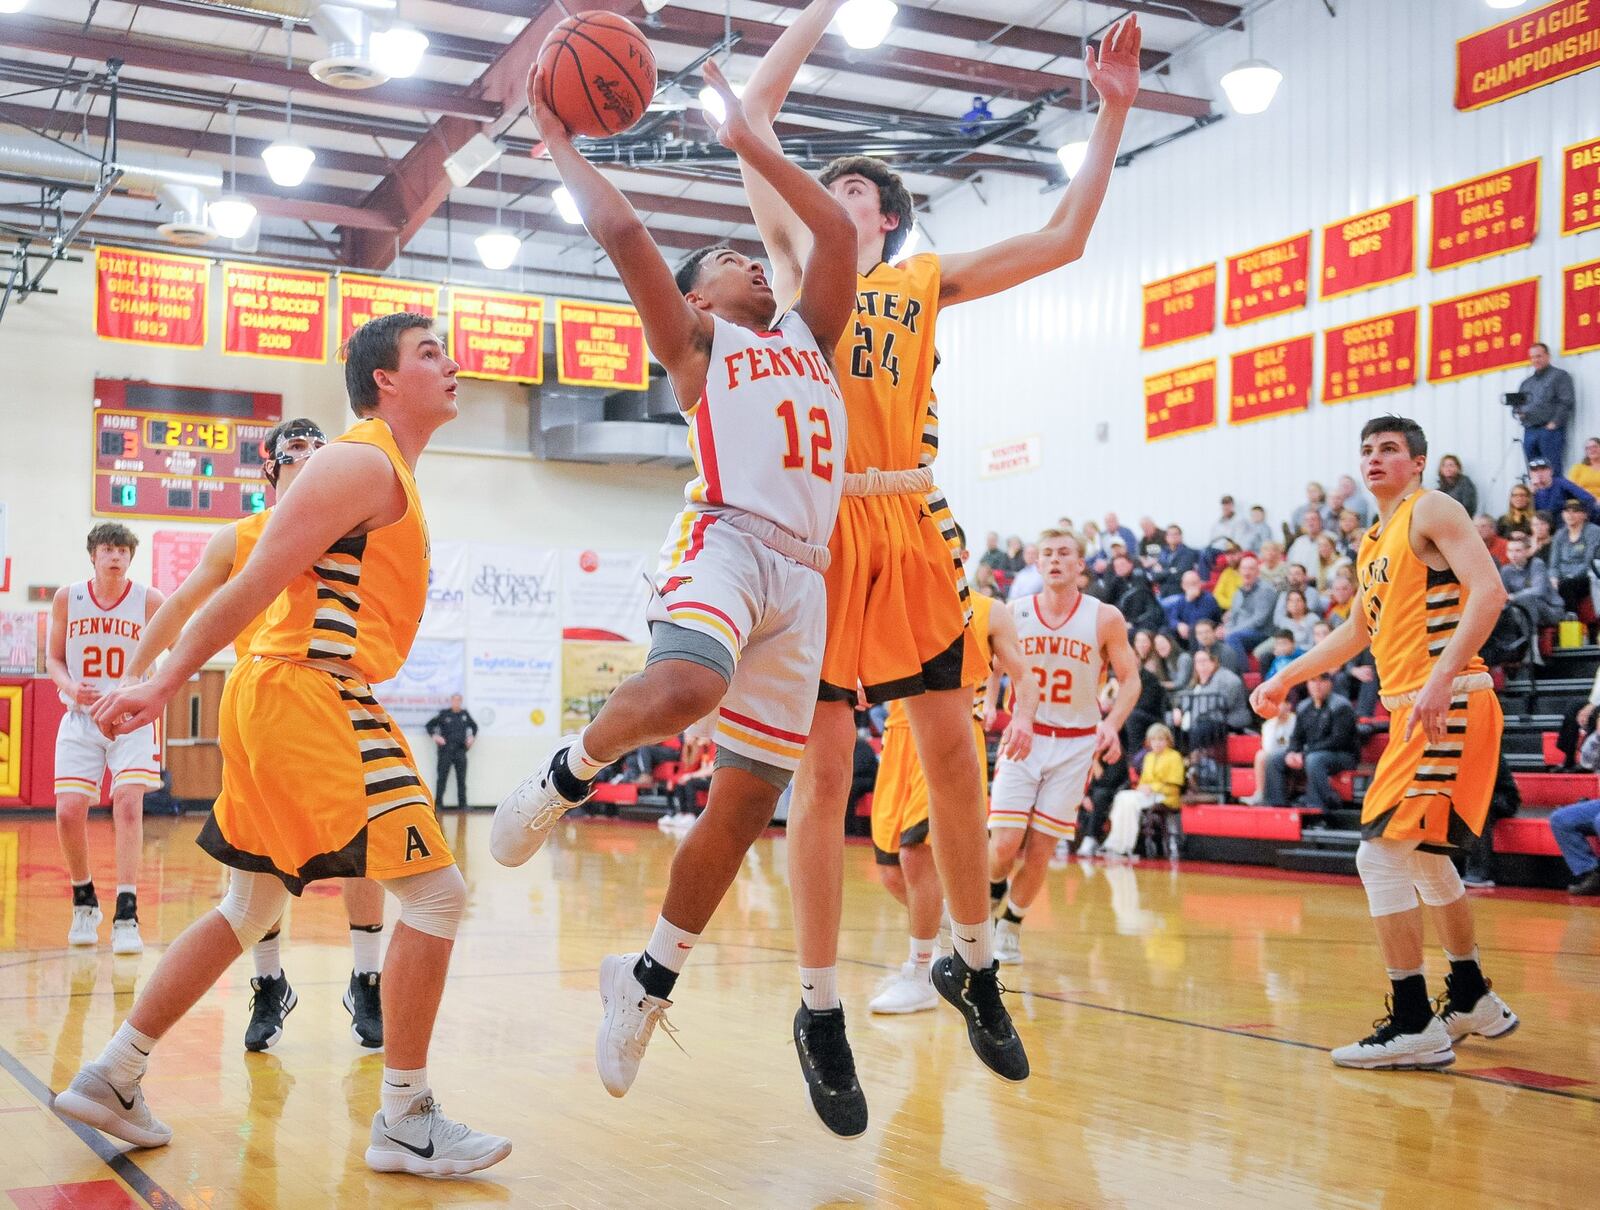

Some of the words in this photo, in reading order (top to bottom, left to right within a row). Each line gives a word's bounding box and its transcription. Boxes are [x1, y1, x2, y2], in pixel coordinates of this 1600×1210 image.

[1508, 0, 1590, 49] LEAGUE
[1455, 175, 1512, 206] TENNIS
[1461, 199, 1505, 225] GIRLS
[1343, 212, 1392, 241] SOCCER
[1349, 234, 1382, 257] BOYS
[98, 257, 138, 276] STATE
[139, 262, 193, 282] DIVISION
[229, 273, 266, 291] STATE
[107, 278, 149, 297] GIRLS
[151, 283, 195, 302] TRACK
[343, 283, 376, 300] STATE
[110, 297, 192, 321] CHAMPIONS
[233, 292, 269, 310] GIRLS
[271, 296, 320, 315] SOCCER
[1455, 291, 1511, 320] TENNIS
[239, 312, 310, 333] CHAMPIONS
[1343, 318, 1395, 345] SOCCER
[1462, 315, 1502, 340] BOYS
[851, 321, 901, 388] 24
[103, 415, 137, 430] HOME
[166, 420, 229, 450] 2:43
[776, 399, 834, 483] 12
[114, 459, 144, 472] BONUS
[121, 484, 136, 507] 0
[481, 565, 545, 592] Brixey
[492, 583, 556, 608] Meyer
[69, 616, 142, 641] FENWICK
[82, 645, 126, 679] 20
[1020, 636, 1093, 666] ENWICK
[405, 825, 432, 863] A
